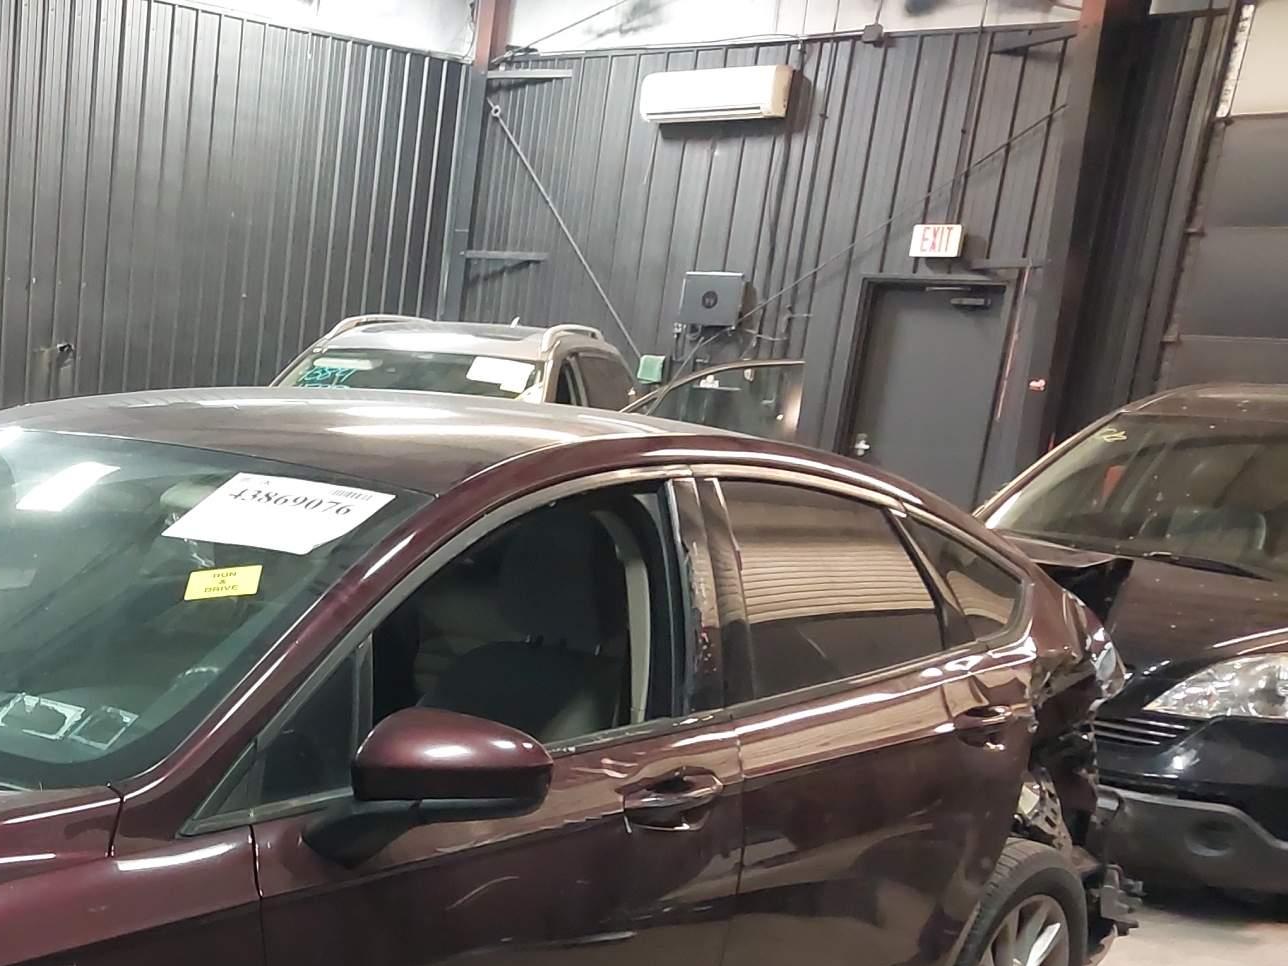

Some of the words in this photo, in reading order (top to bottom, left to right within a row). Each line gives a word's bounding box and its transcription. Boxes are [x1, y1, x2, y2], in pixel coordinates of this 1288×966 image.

[919, 226, 954, 253] EXIT
[228, 488, 353, 515] 43869076
[204, 584, 239, 593] DRIVE
